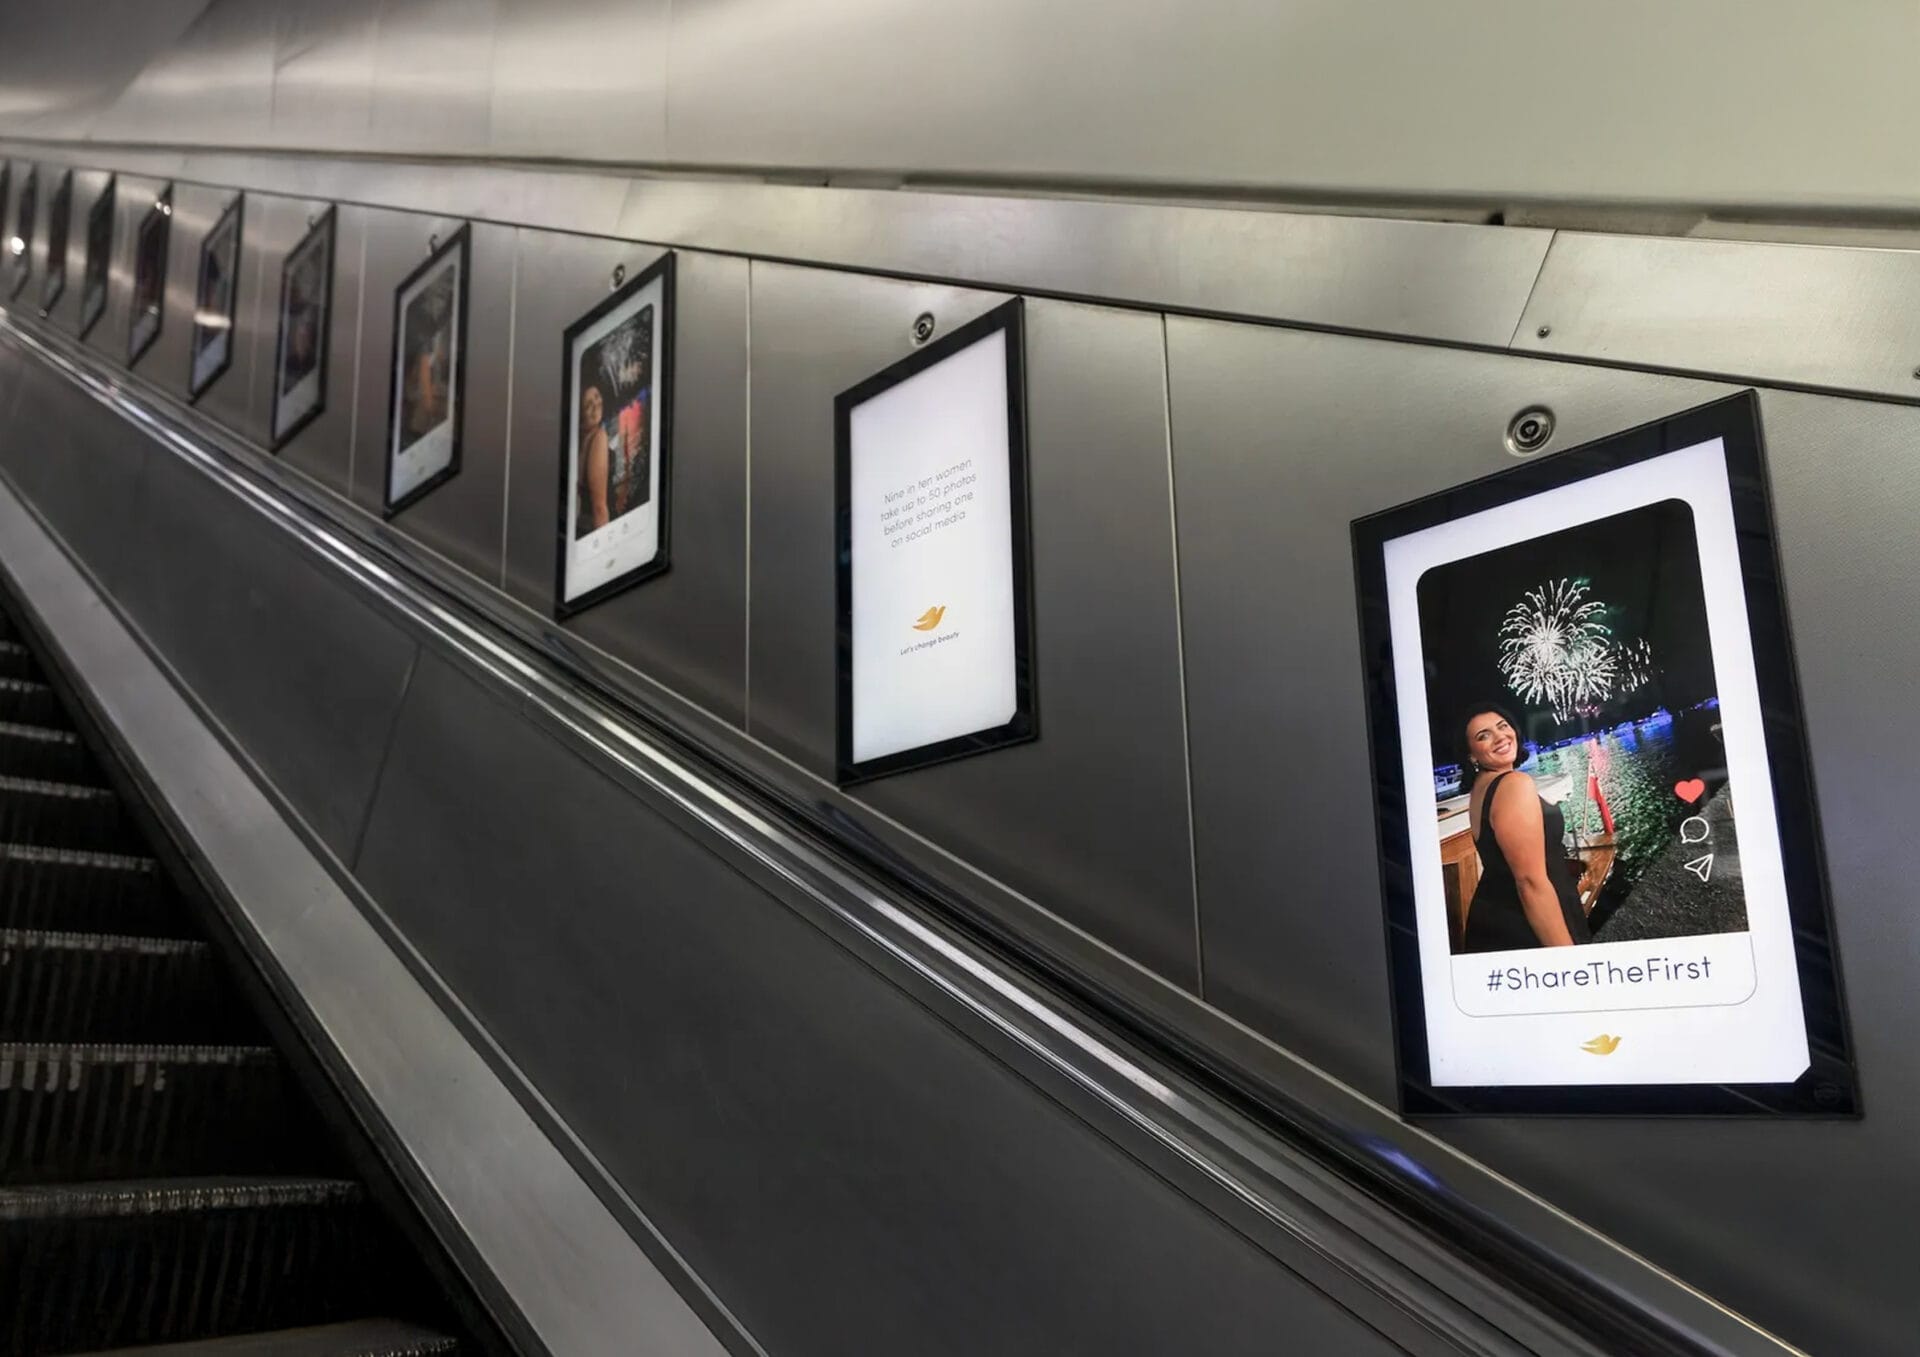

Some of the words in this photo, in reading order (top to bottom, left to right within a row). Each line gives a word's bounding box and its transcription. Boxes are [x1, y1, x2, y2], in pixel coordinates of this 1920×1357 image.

[880, 506, 899, 522] take
[902, 500, 914, 512] up
[917, 495, 926, 507] to
[929, 488, 940, 501] 50
[943, 474, 977, 496] photos
[884, 489, 905, 504] Nine
[907, 485, 915, 495] in
[918, 477, 932, 490] ten
[936, 459, 972, 481] women
[883, 514, 914, 536] before
[916, 500, 952, 522] sharing
[954, 492, 974, 506] one
[891, 537, 903, 548] on
[905, 524, 932, 542] social
[935, 510, 966, 530] media
[1487, 955, 1712, 992] #ShareTheFirst
